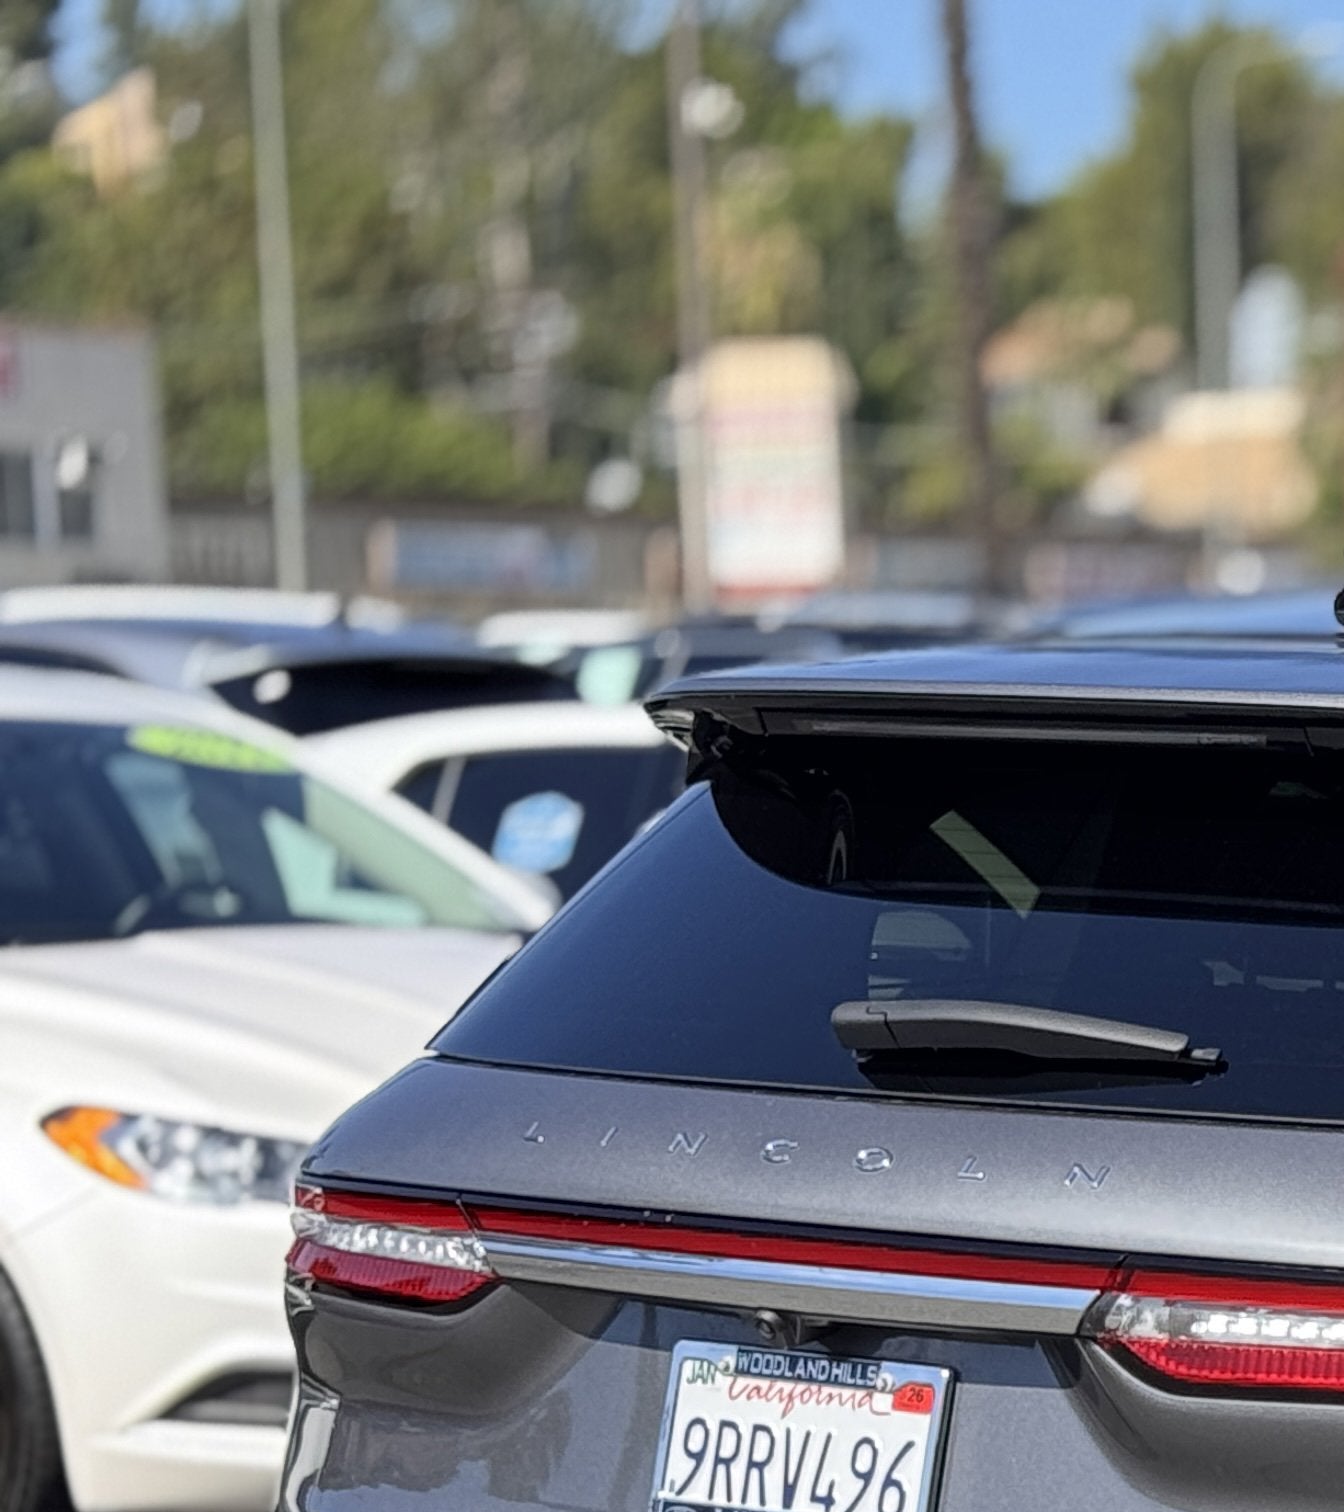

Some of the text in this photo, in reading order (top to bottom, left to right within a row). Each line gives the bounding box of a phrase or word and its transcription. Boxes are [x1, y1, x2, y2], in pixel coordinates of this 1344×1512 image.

[523, 1120, 1111, 1188] LINCOLN
[686, 1362, 716, 1385] JAN
[738, 1351, 878, 1388] WOODLAND HILLS
[728, 1376, 891, 1419] California
[907, 1386, 924, 1403] 26
